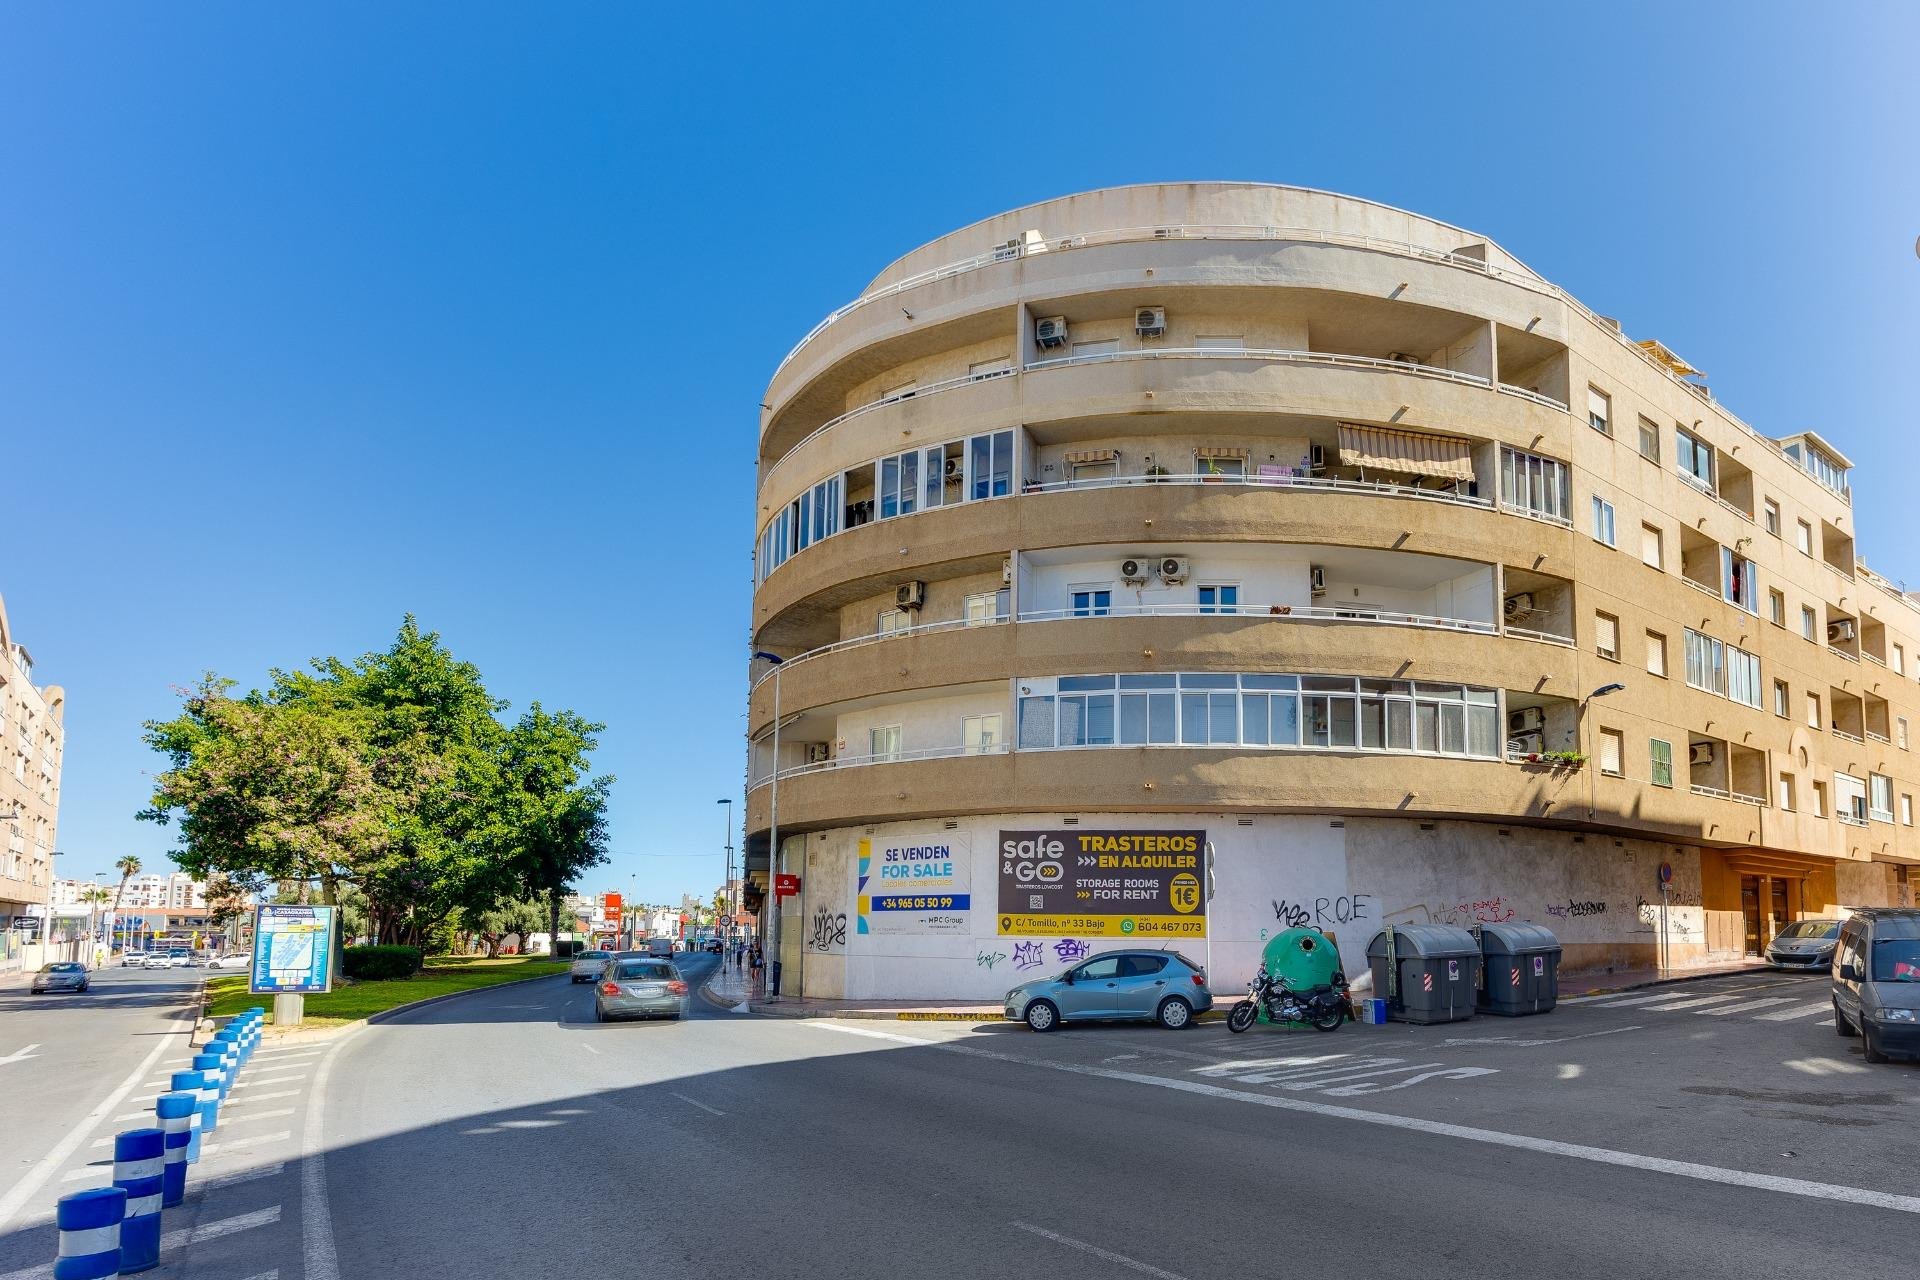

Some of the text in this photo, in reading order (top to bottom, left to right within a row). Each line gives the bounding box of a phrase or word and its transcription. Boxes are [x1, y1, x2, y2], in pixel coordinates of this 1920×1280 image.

[1003, 835, 1064, 858] safe
[1079, 836, 1196, 852] TRASTEROS
[885, 845, 950, 861] SE VENDEN
[1099, 855, 1196, 868] EN ALQUILER
[882, 862, 953, 878] FOR SALE
[1076, 879, 1159, 888] STORAGE ROOMS
[1093, 890, 1159, 900] FOR RENT
[1174, 887, 1196, 906] 1€
[881, 897, 953, 909] +34 965 05 50 99
[944, 916, 964, 925] Group
[1015, 918, 1026, 927] C/
[1028, 918, 1059, 929] Tomillo,
[1072, 919, 1084, 928] 33
[1086, 919, 1105, 930] Bajo
[1138, 922, 1202, 932] 604 467 073
